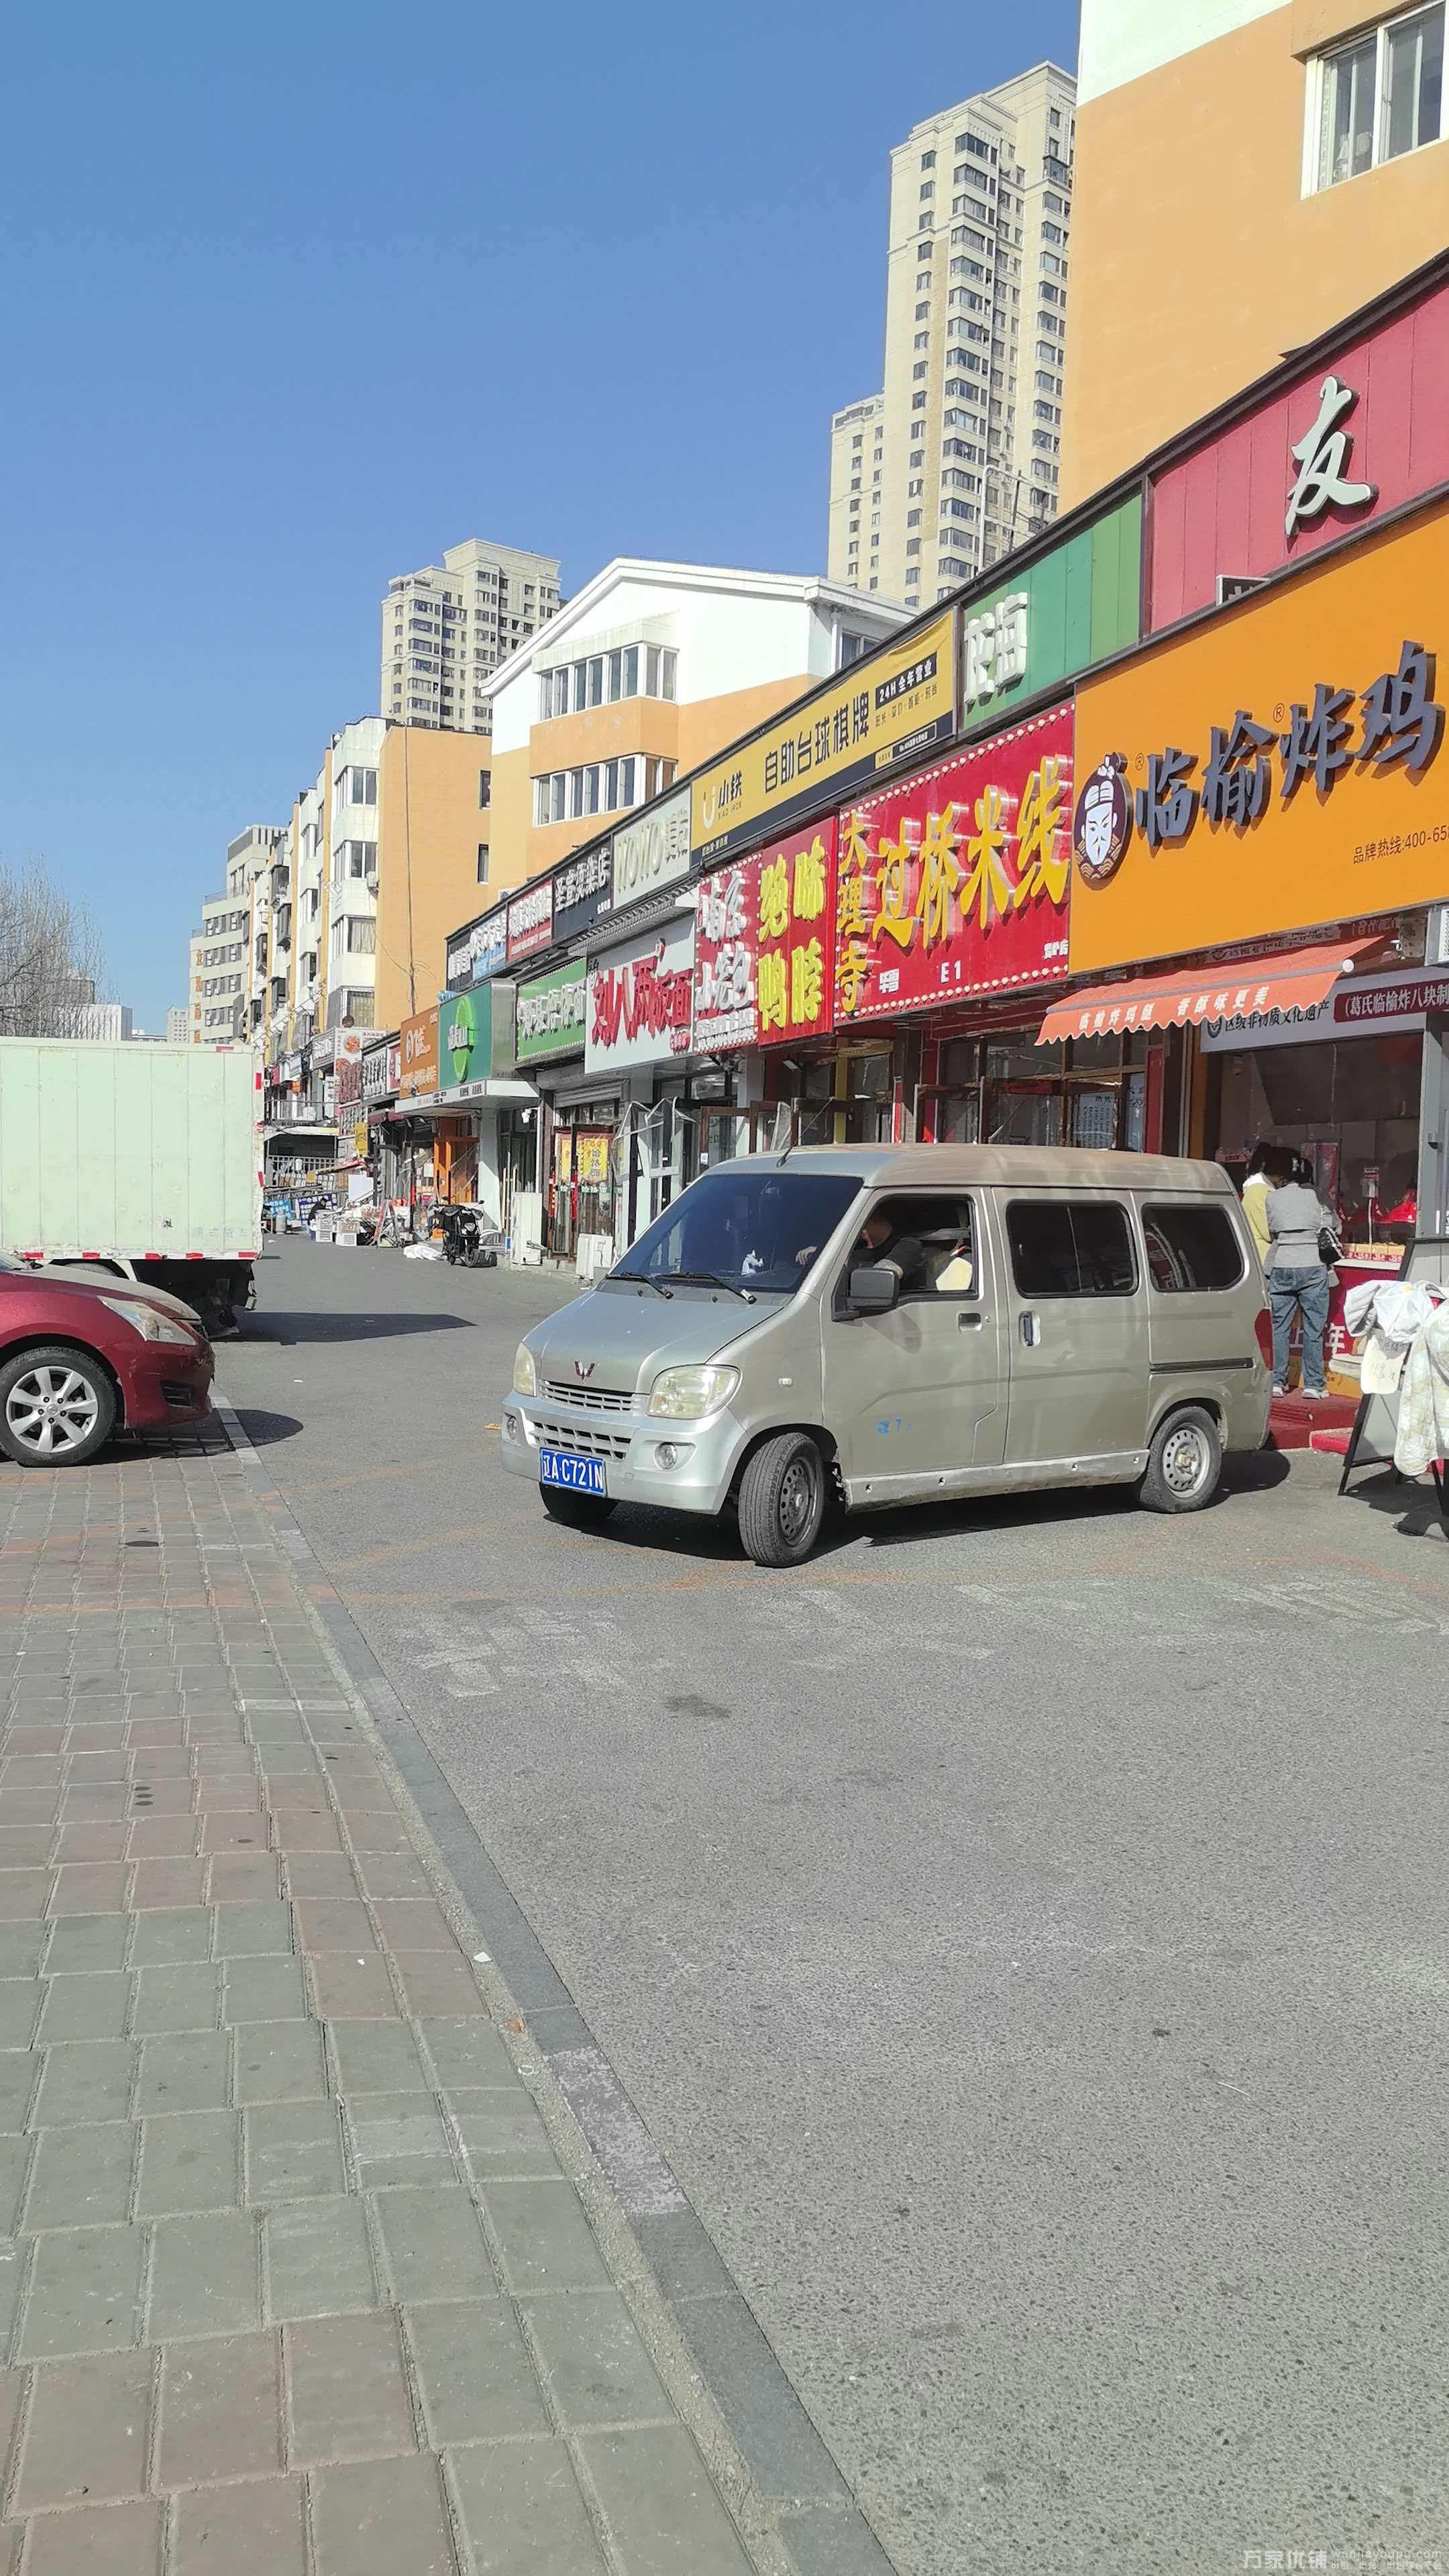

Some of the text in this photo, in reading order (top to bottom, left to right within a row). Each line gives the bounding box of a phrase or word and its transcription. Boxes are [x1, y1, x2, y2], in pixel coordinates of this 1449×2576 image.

[718, 770, 743, 809] 小铁
[764, 691, 870, 794] 自助台球棋牌
[1136, 641, 1444, 847] 临榆炸鸡
[873, 754, 1070, 949] 过桥米线
[1353, 824, 1449, 864] 品牌热线:400-65
[836, 810, 871, 1012] 大理寺
[757, 936, 824, 1032] 鸭脖
[1177, 985, 1271, 1017] 香酥味更美
